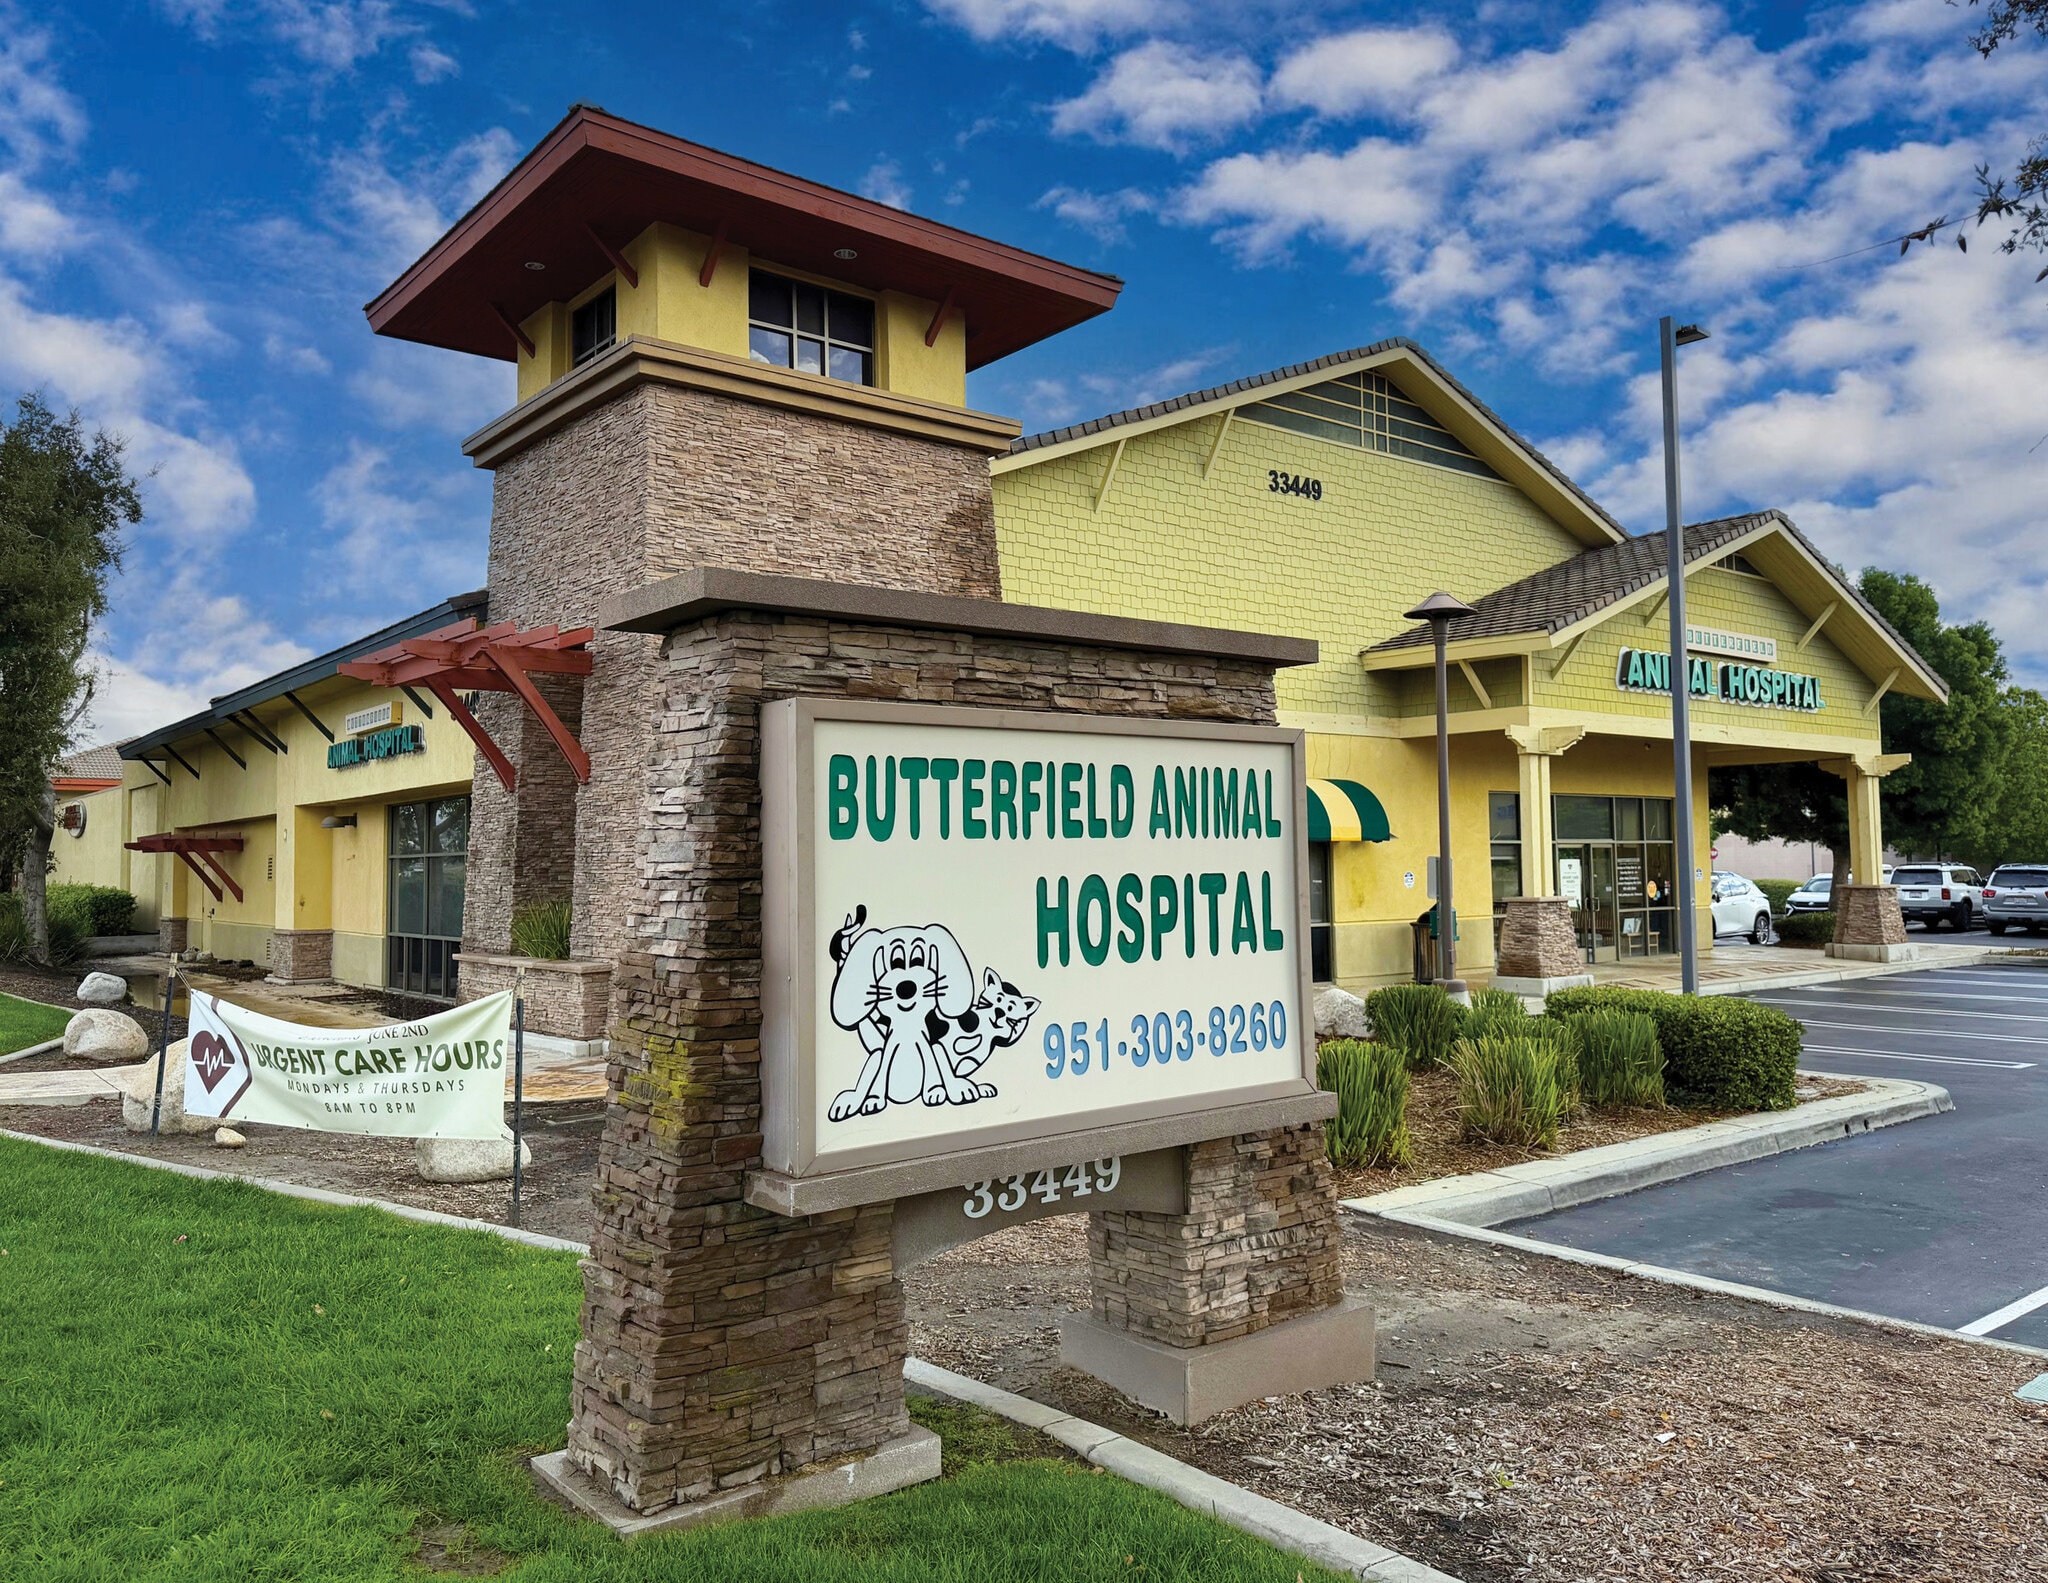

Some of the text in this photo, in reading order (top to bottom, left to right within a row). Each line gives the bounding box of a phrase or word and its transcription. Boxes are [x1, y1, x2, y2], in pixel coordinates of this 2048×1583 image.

[1268, 470, 1322, 500] 33449
[1687, 629, 1774, 656] BUTTERFIELD
[1627, 649, 1827, 708] ANIAL HOSPITAL
[327, 725, 415, 769] ANIMAL HOSPITAL
[828, 754, 1282, 842] BUTTERFIELD ANIMAL
[1036, 871, 1284, 969] HOSPITAL
[367, 1026, 399, 1044] JUNE
[402, 1025, 429, 1038] 2ND
[250, 1039, 504, 1076] URGENT CARE HOURS
[287, 1079, 465, 1094] MONDAYS & THURSDAYS
[324, 1101, 417, 1114] 8AM TO 8PM
[963, 1156, 1121, 1219] 33449
